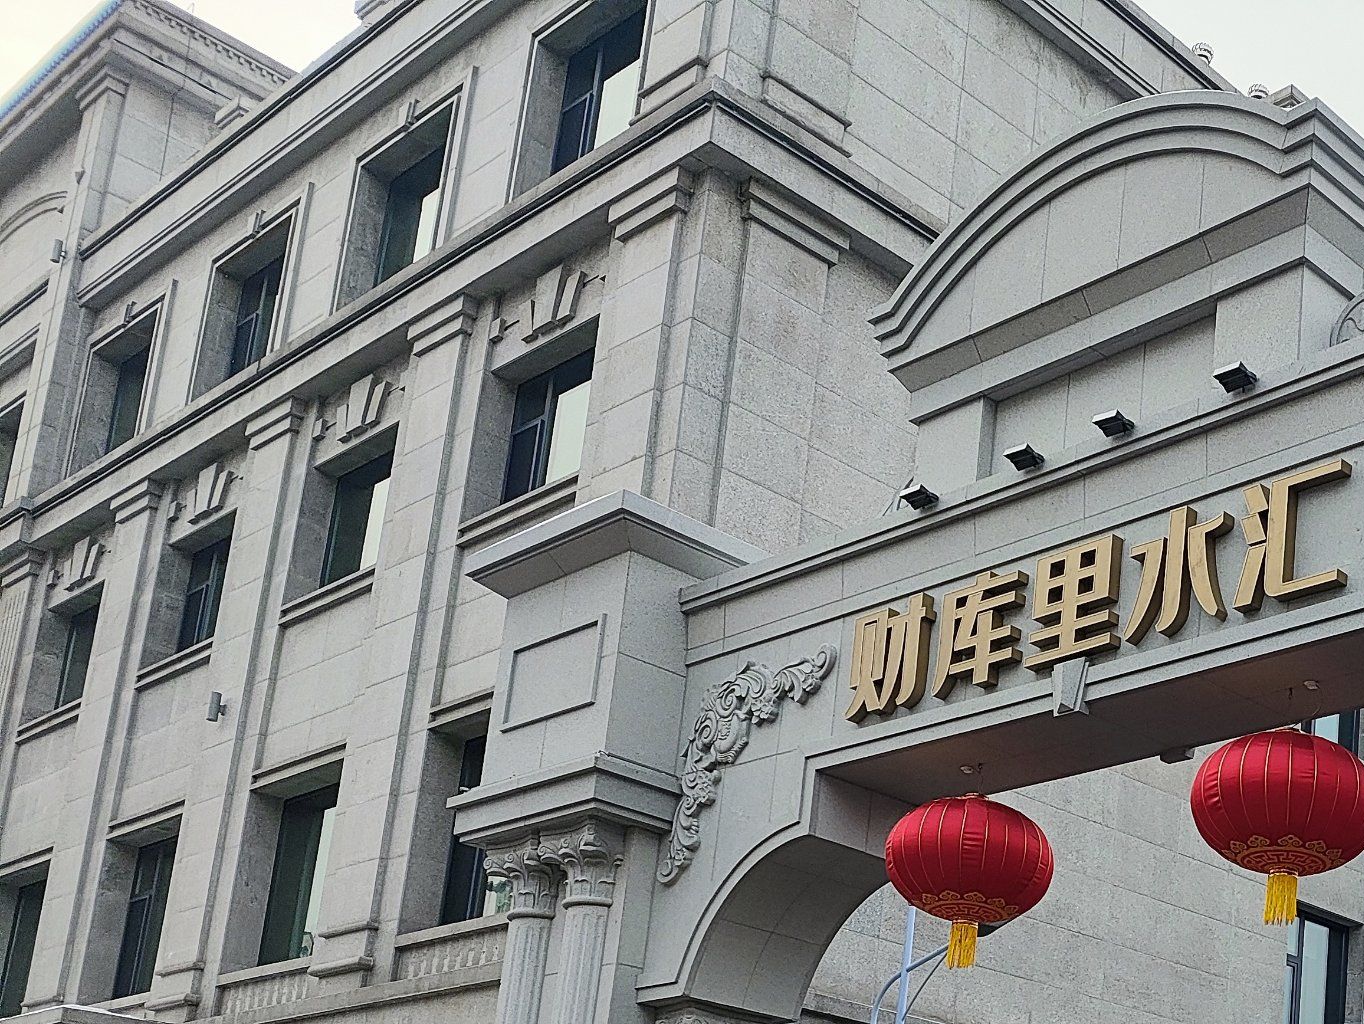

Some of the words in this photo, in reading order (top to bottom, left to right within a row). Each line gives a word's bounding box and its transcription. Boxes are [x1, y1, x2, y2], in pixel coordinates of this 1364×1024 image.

[845, 458, 1352, 724] 财库里水汇
